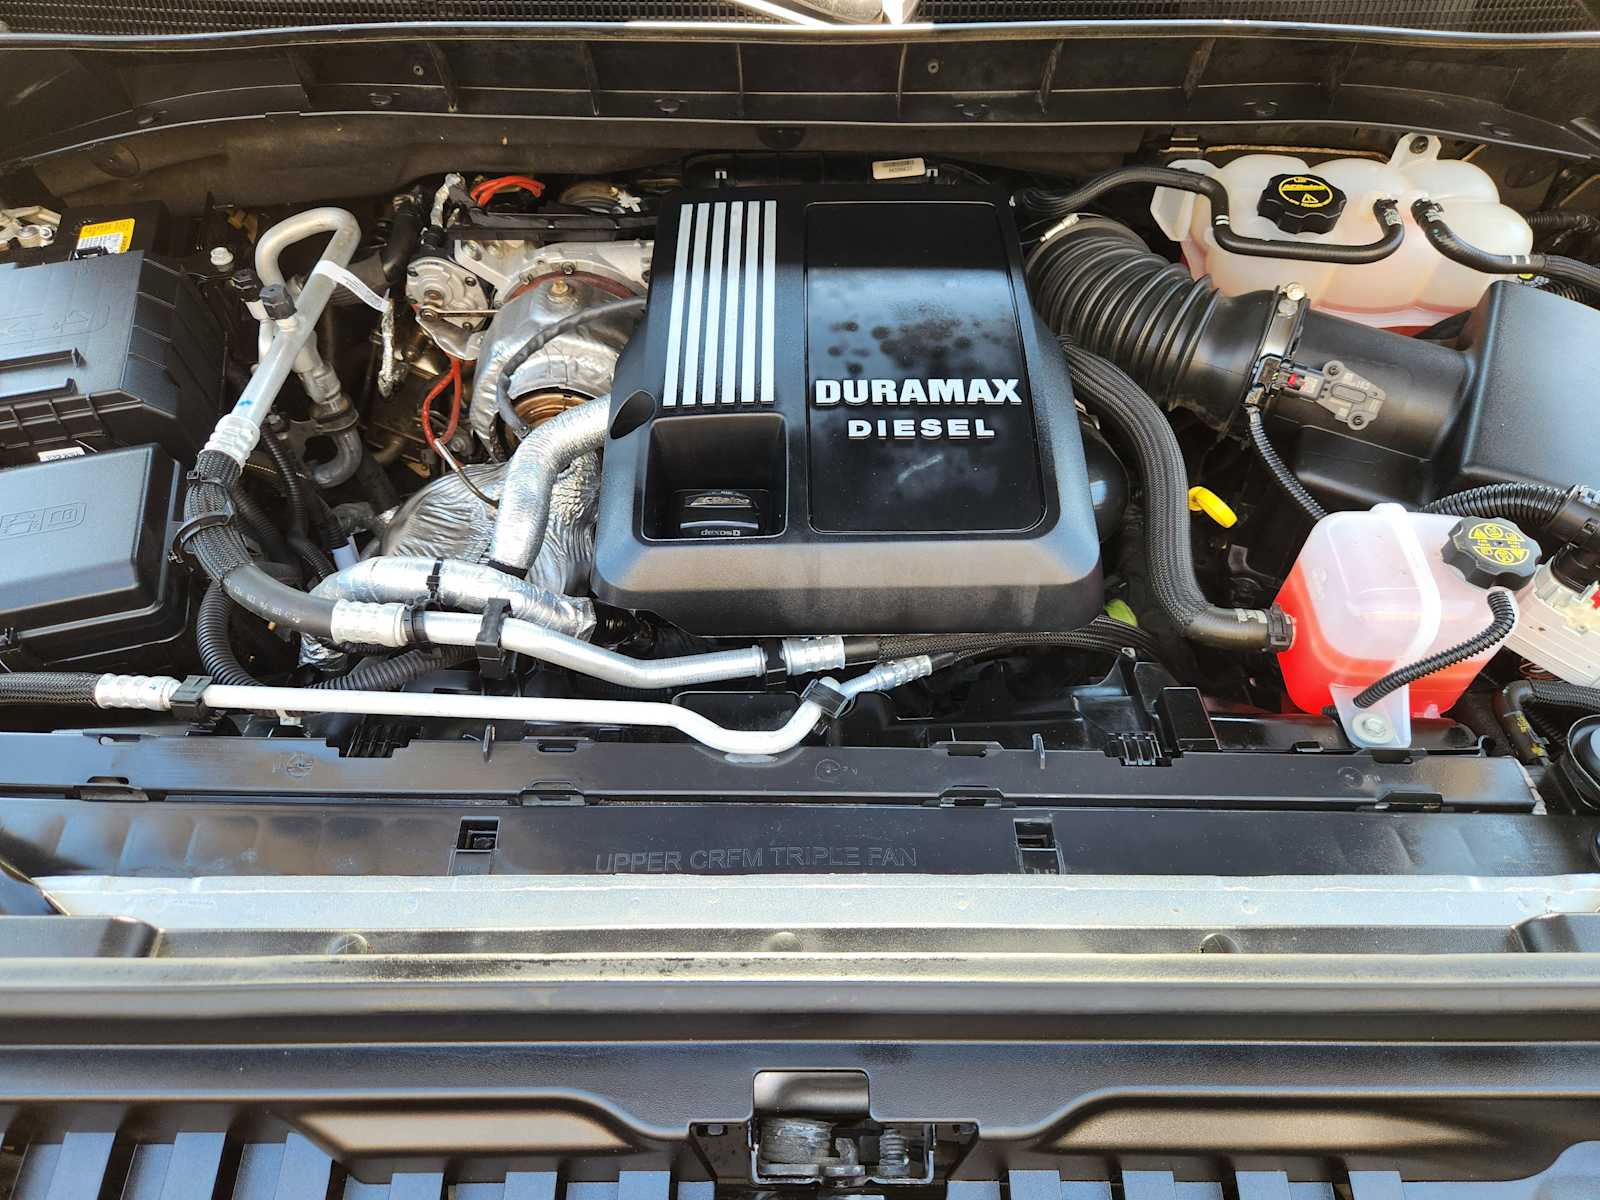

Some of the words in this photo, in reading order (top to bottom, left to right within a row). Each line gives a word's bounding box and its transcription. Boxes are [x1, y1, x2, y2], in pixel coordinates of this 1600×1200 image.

[814, 378, 1023, 406] DURAMAX
[847, 418, 996, 440] DIESEL
[595, 850, 683, 873] UPPER
[689, 847, 763, 870] CRFM
[769, 846, 862, 867] TRIPLE
[868, 846, 918, 867] FAN
